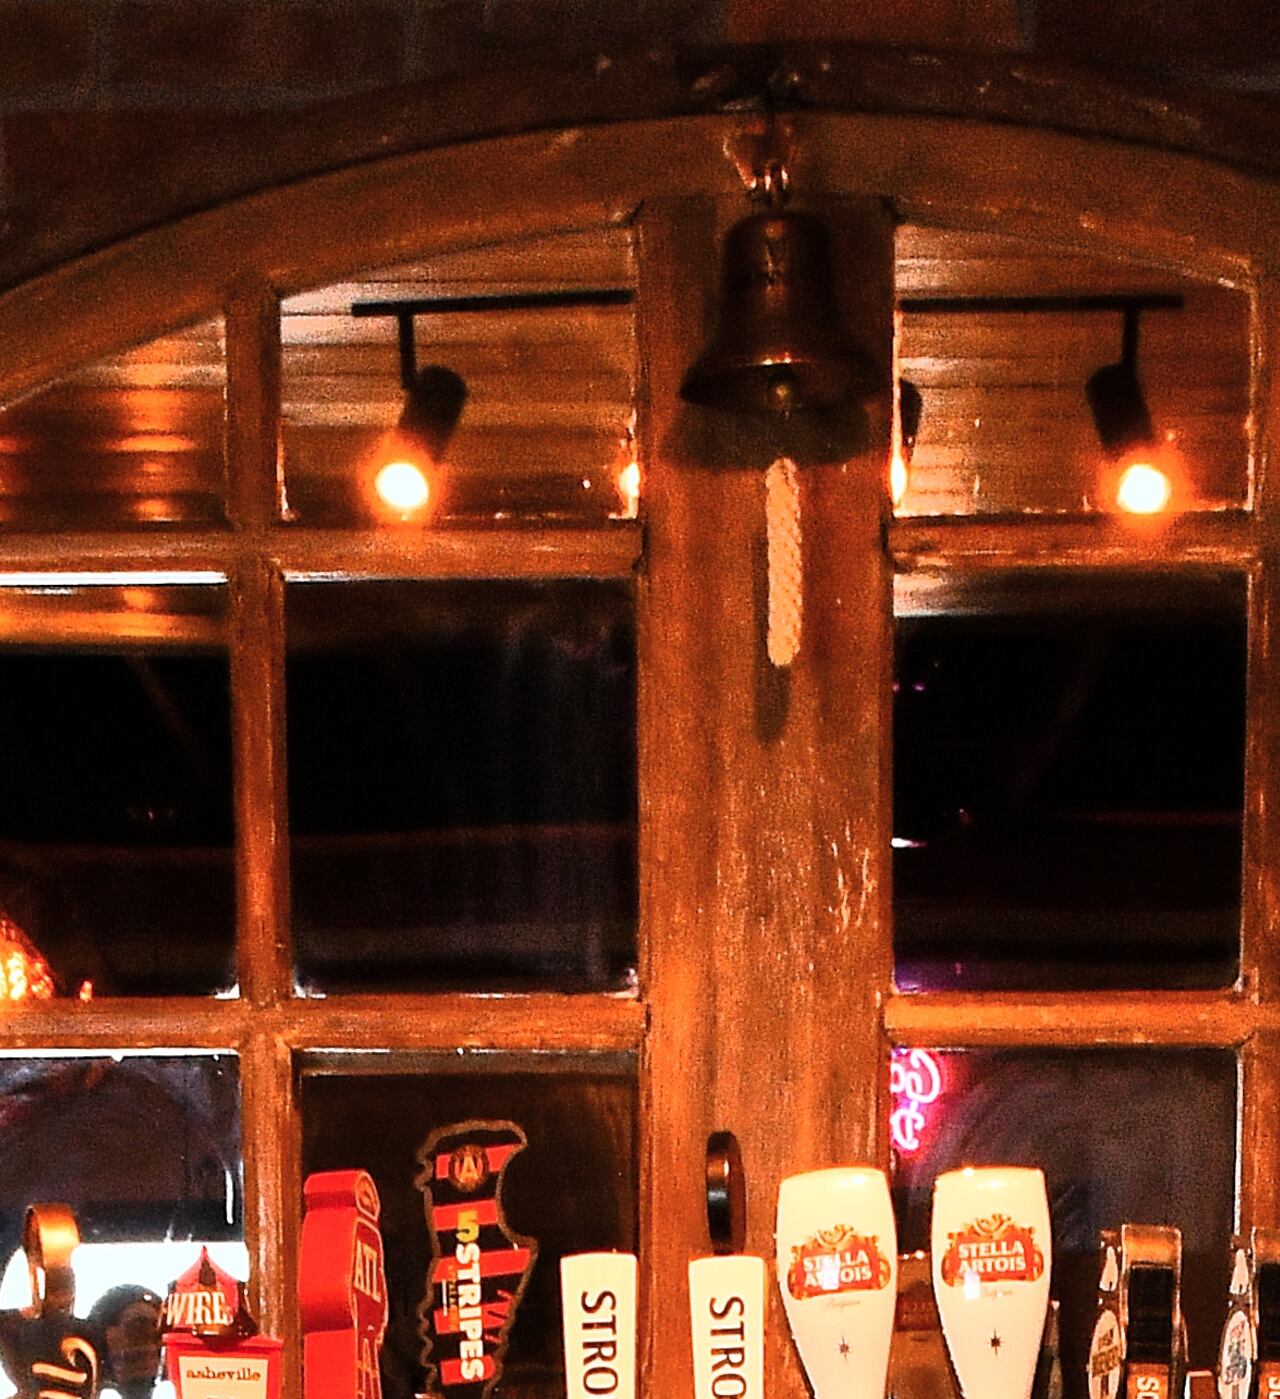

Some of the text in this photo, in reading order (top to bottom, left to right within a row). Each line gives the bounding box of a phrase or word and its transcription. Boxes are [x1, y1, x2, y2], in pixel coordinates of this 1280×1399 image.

[958, 1241, 1024, 1258] STELLA
[958, 1256, 1026, 1274] ARTOIS
[186, 1367, 261, 1382] asheville
